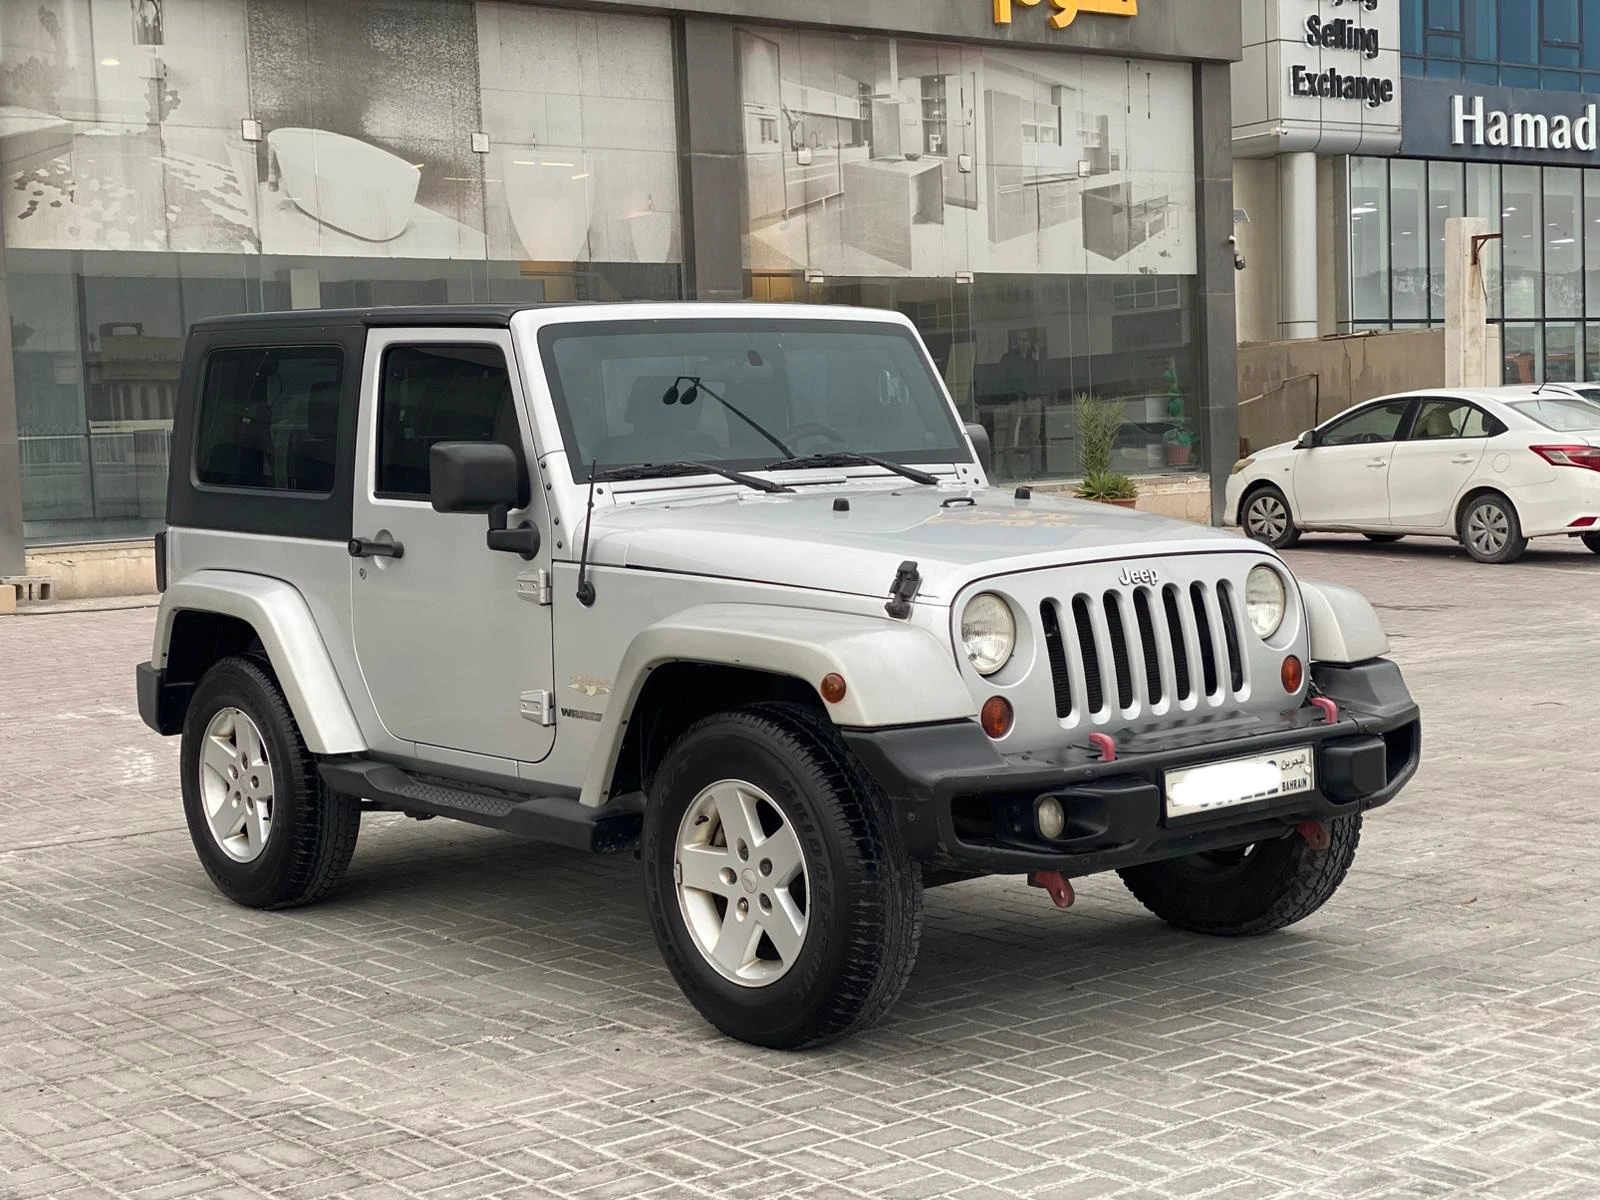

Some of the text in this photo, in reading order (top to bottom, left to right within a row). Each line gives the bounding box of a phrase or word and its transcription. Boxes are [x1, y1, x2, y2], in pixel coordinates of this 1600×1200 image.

[1305, 14, 1379, 60] Selling
[1290, 64, 1393, 108] Exchange
[1451, 94, 1597, 151] Hamad
[1119, 567, 1159, 586] Jeep
[1282, 777, 1307, 792] BAHRAIN
